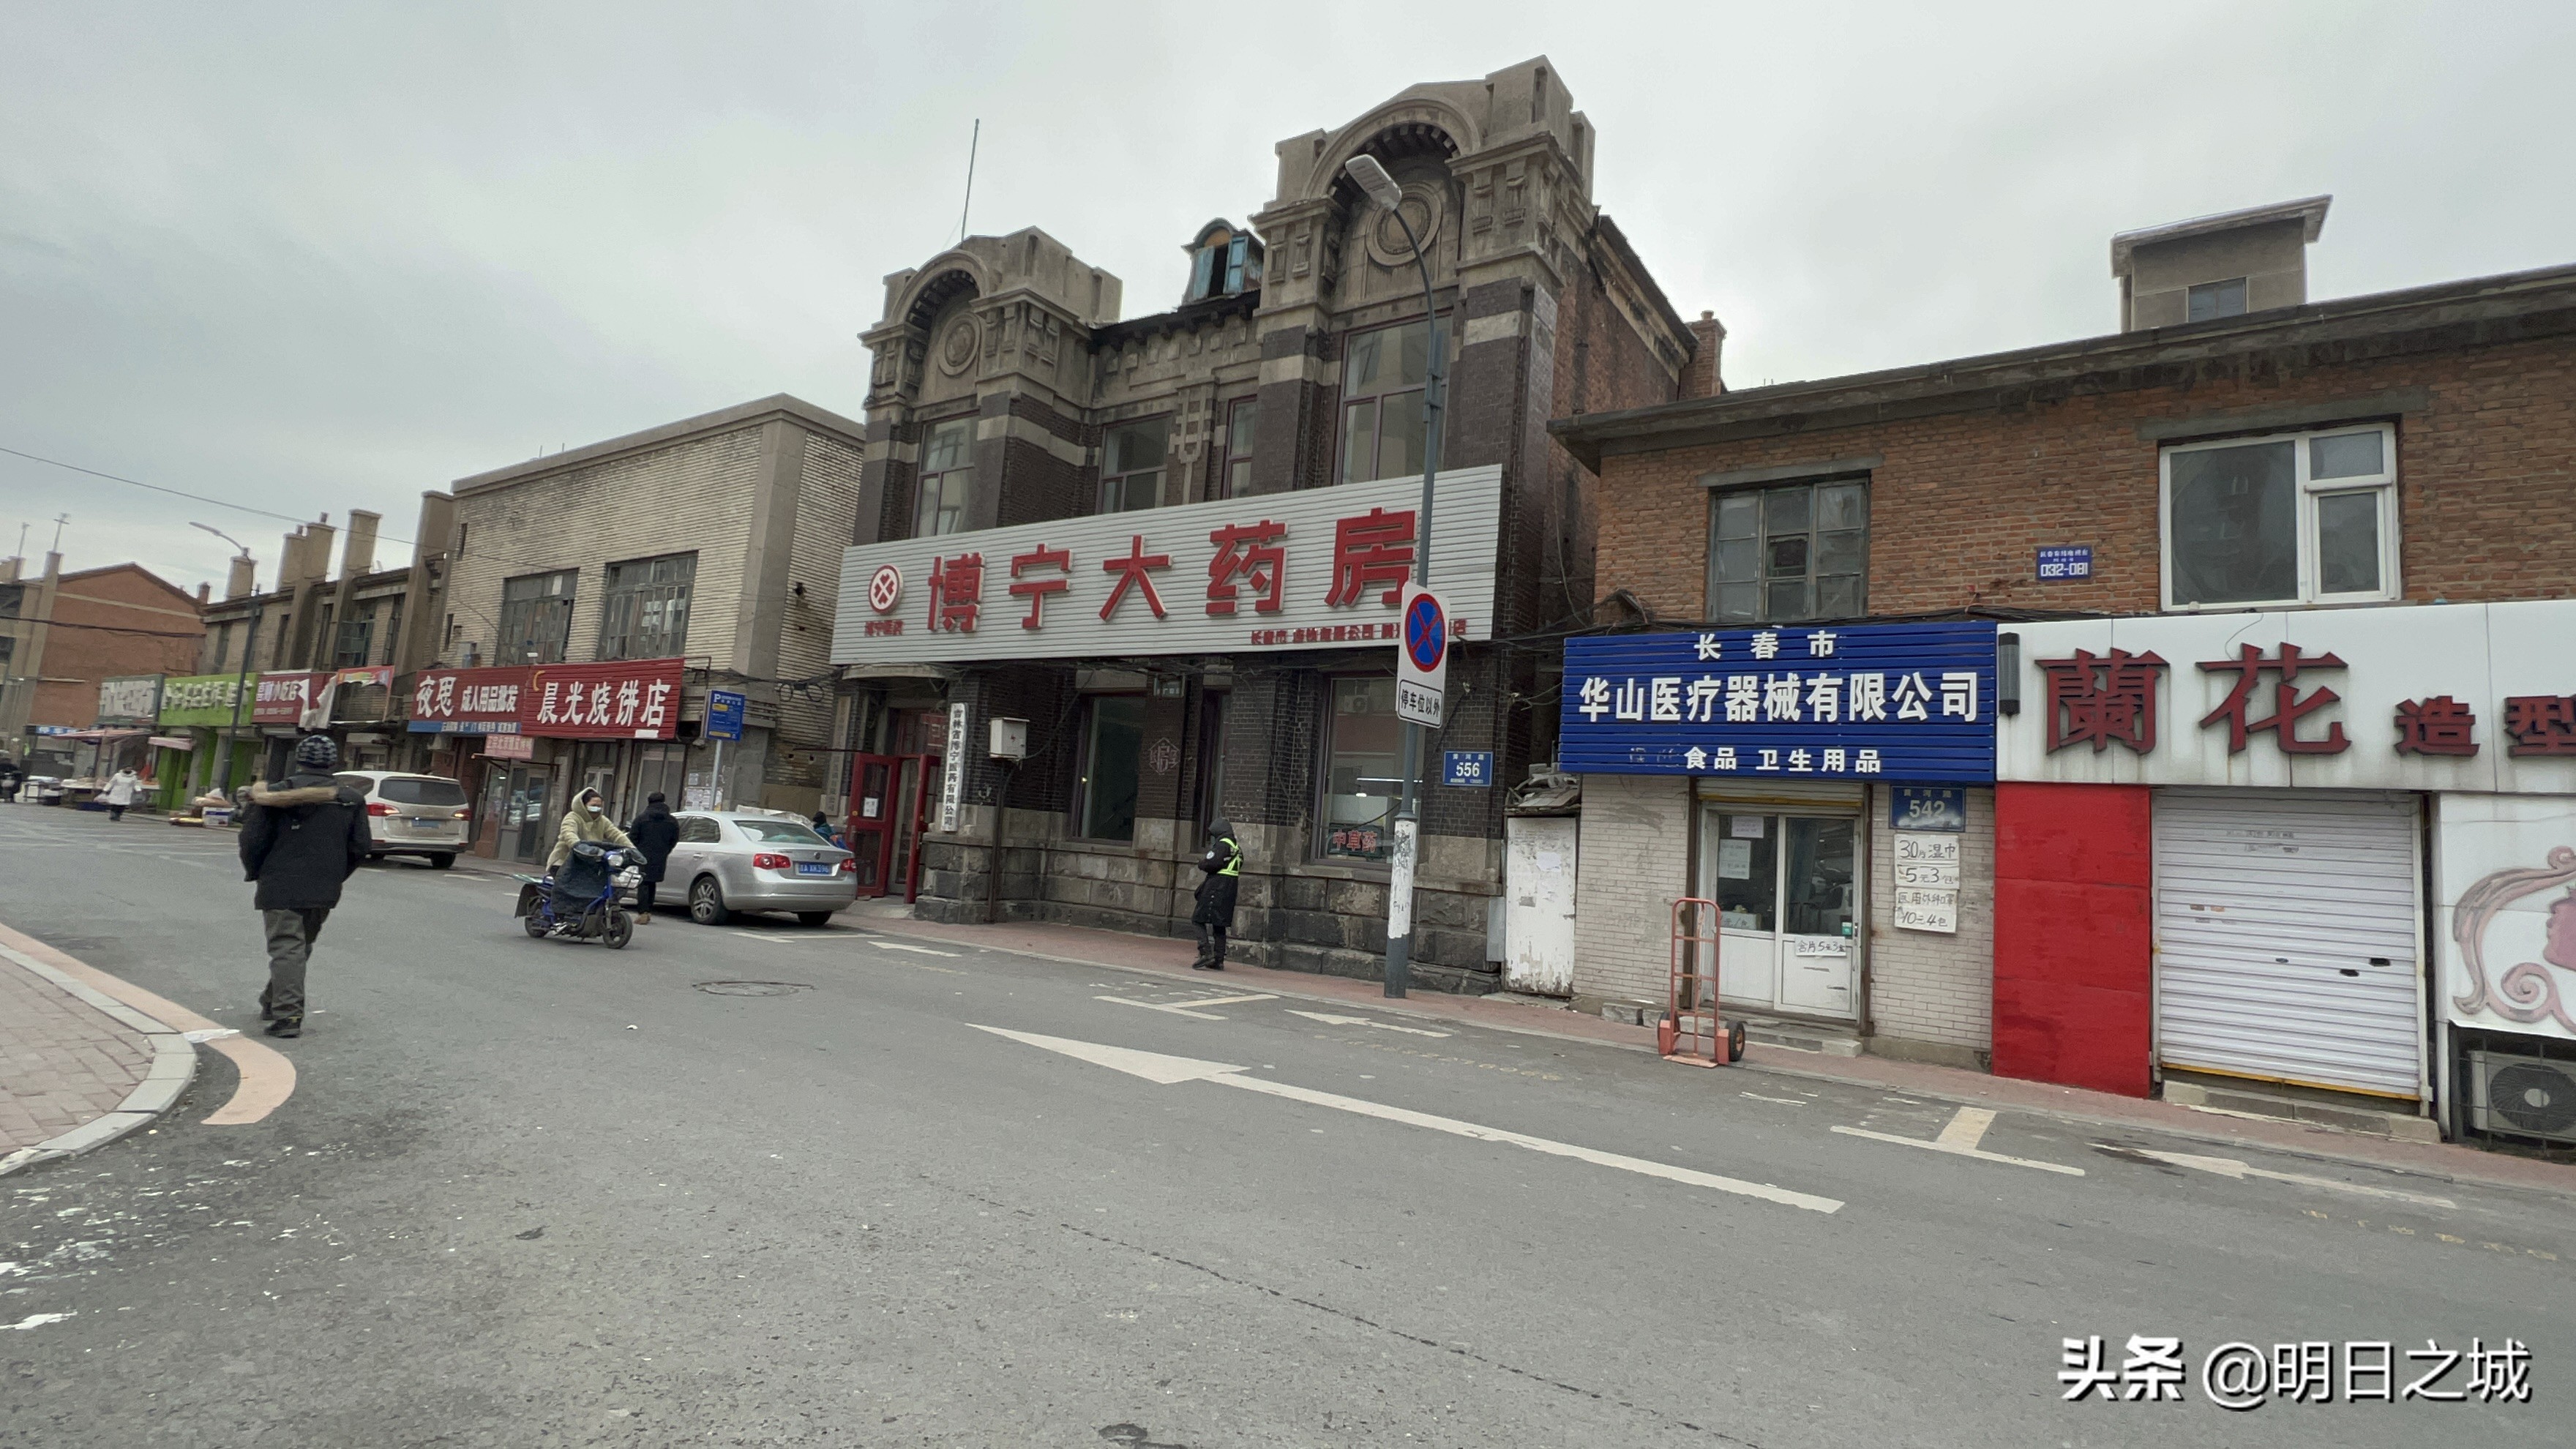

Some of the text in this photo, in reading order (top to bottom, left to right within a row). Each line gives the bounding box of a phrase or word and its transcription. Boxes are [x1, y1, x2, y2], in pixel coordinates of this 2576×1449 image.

[927, 507, 1420, 633] 博宁大药房
[2040, 563, 2088, 577] 032-081
[1694, 630, 1838, 661] 长春市
[460, 685, 519, 712] 成人用品批发
[536, 678, 671, 727] 晨光烧饼店
[713, 693, 721, 703] P
[1401, 688, 1440, 718] 停车位以外
[1579, 672, 1978, 722] 华山医疗器械有限公司
[1456, 762, 1480, 777] 556
[1684, 747, 1737, 770] 食品
[1756, 749, 1882, 774] 卫生用品
[1909, 800, 1945, 818] 542
[1333, 828, 1377, 853] 中草药
[1905, 867, 1955, 884] 5元3包
